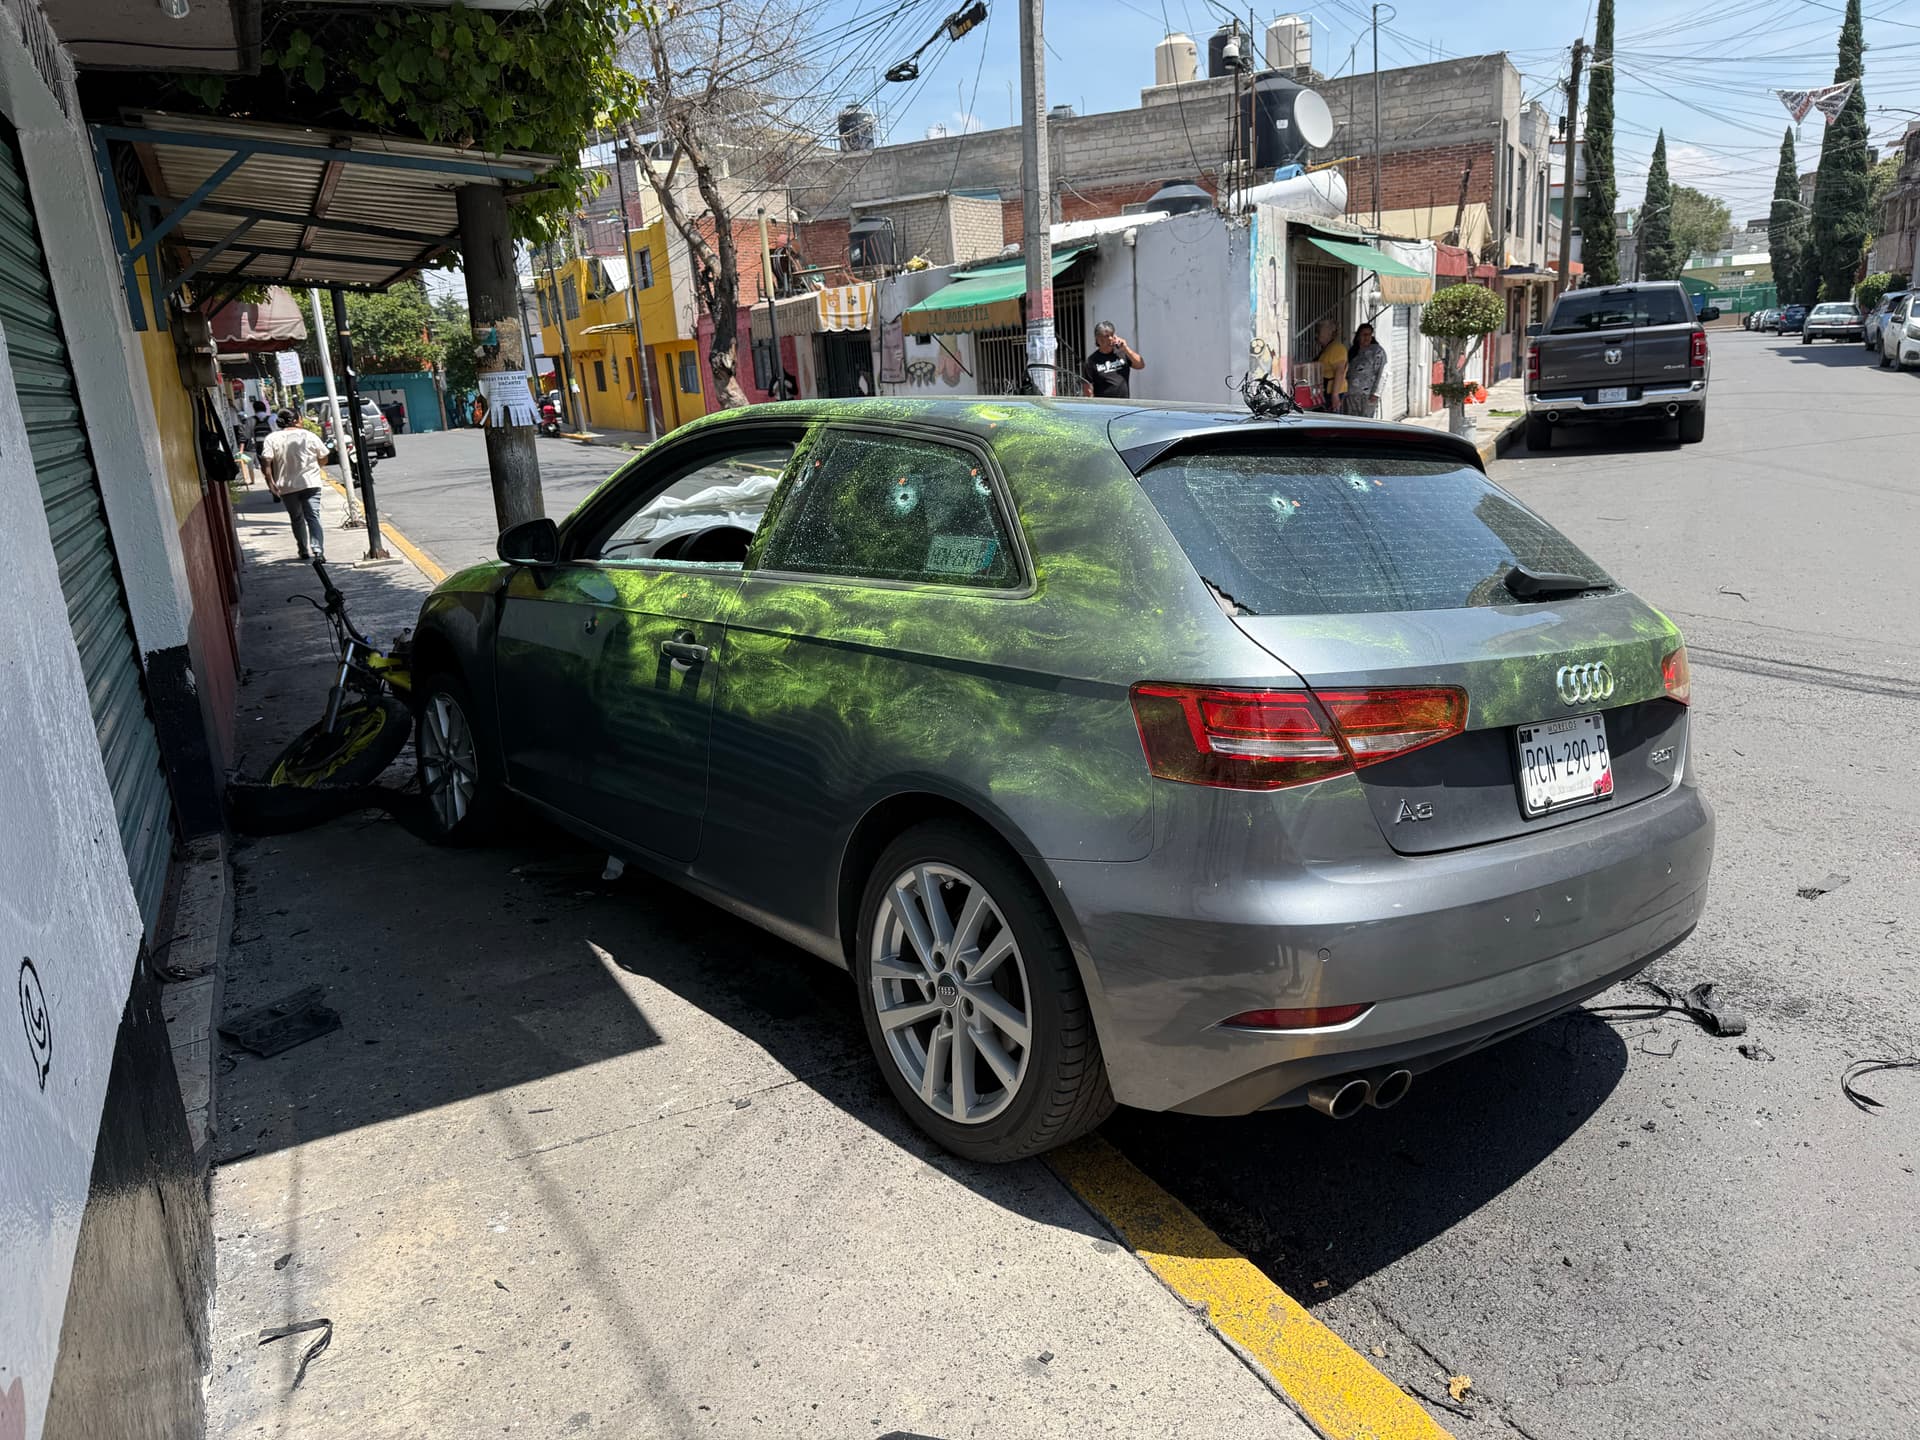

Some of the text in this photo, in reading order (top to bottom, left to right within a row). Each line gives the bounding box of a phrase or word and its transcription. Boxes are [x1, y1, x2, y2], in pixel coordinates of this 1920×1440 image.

[1546, 720, 1577, 732] MORELOS
[1525, 734, 1608, 787] RCN-290-B
[1394, 798, 1434, 824] A3
